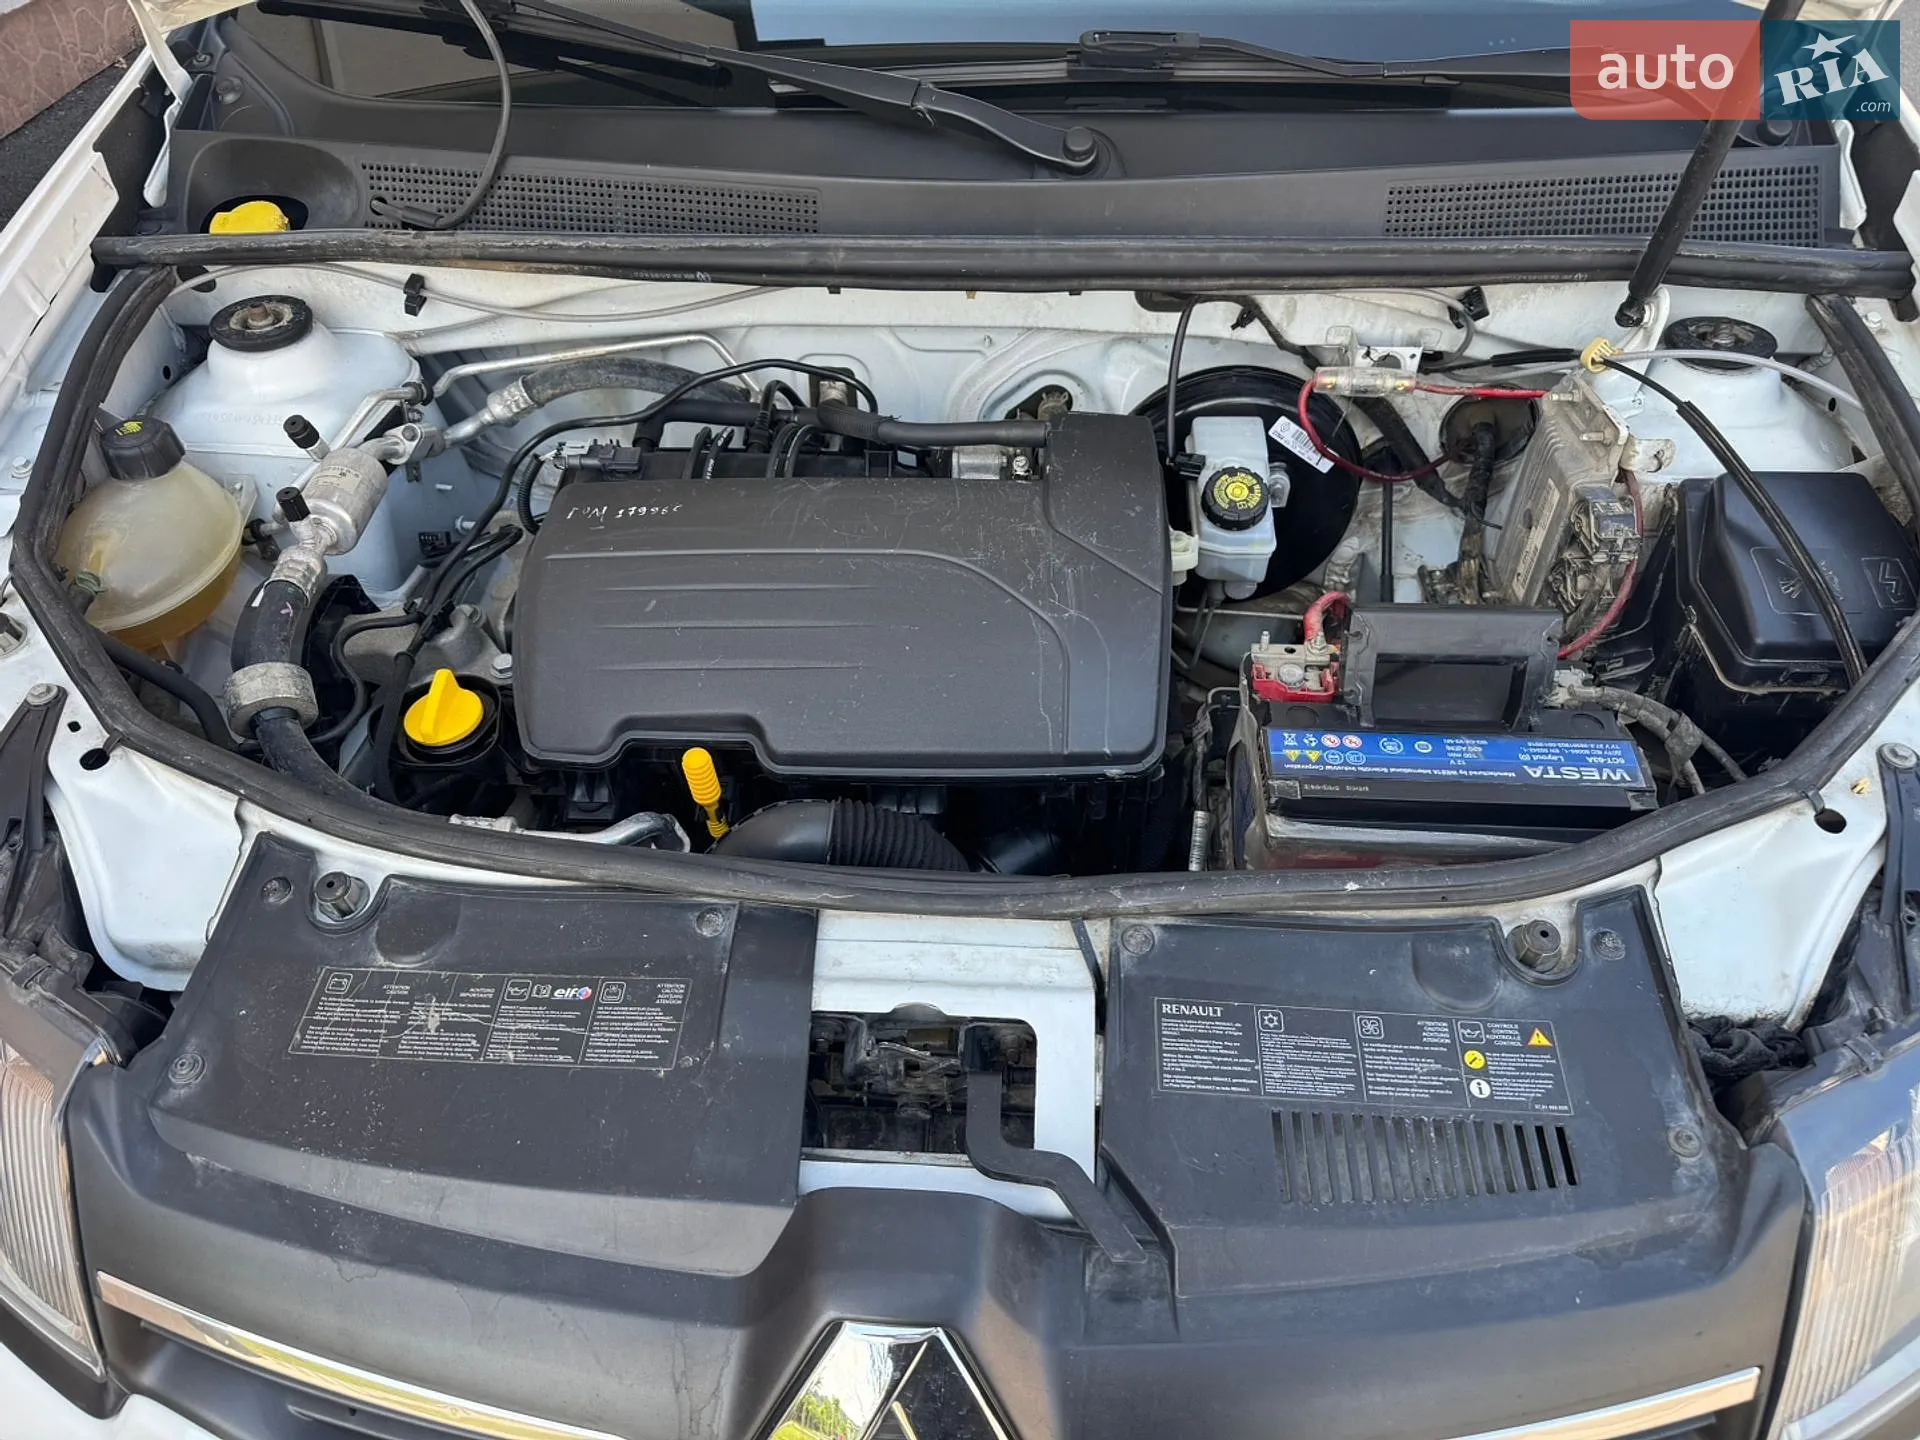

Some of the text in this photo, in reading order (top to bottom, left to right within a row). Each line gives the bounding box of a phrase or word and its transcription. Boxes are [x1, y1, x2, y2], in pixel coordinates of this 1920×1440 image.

[1532, 754, 1564, 762] Layout
[1522, 765, 1632, 782] WESTA
[553, 986, 580, 998] elf
[1161, 1003, 1224, 1017] RENAULT
